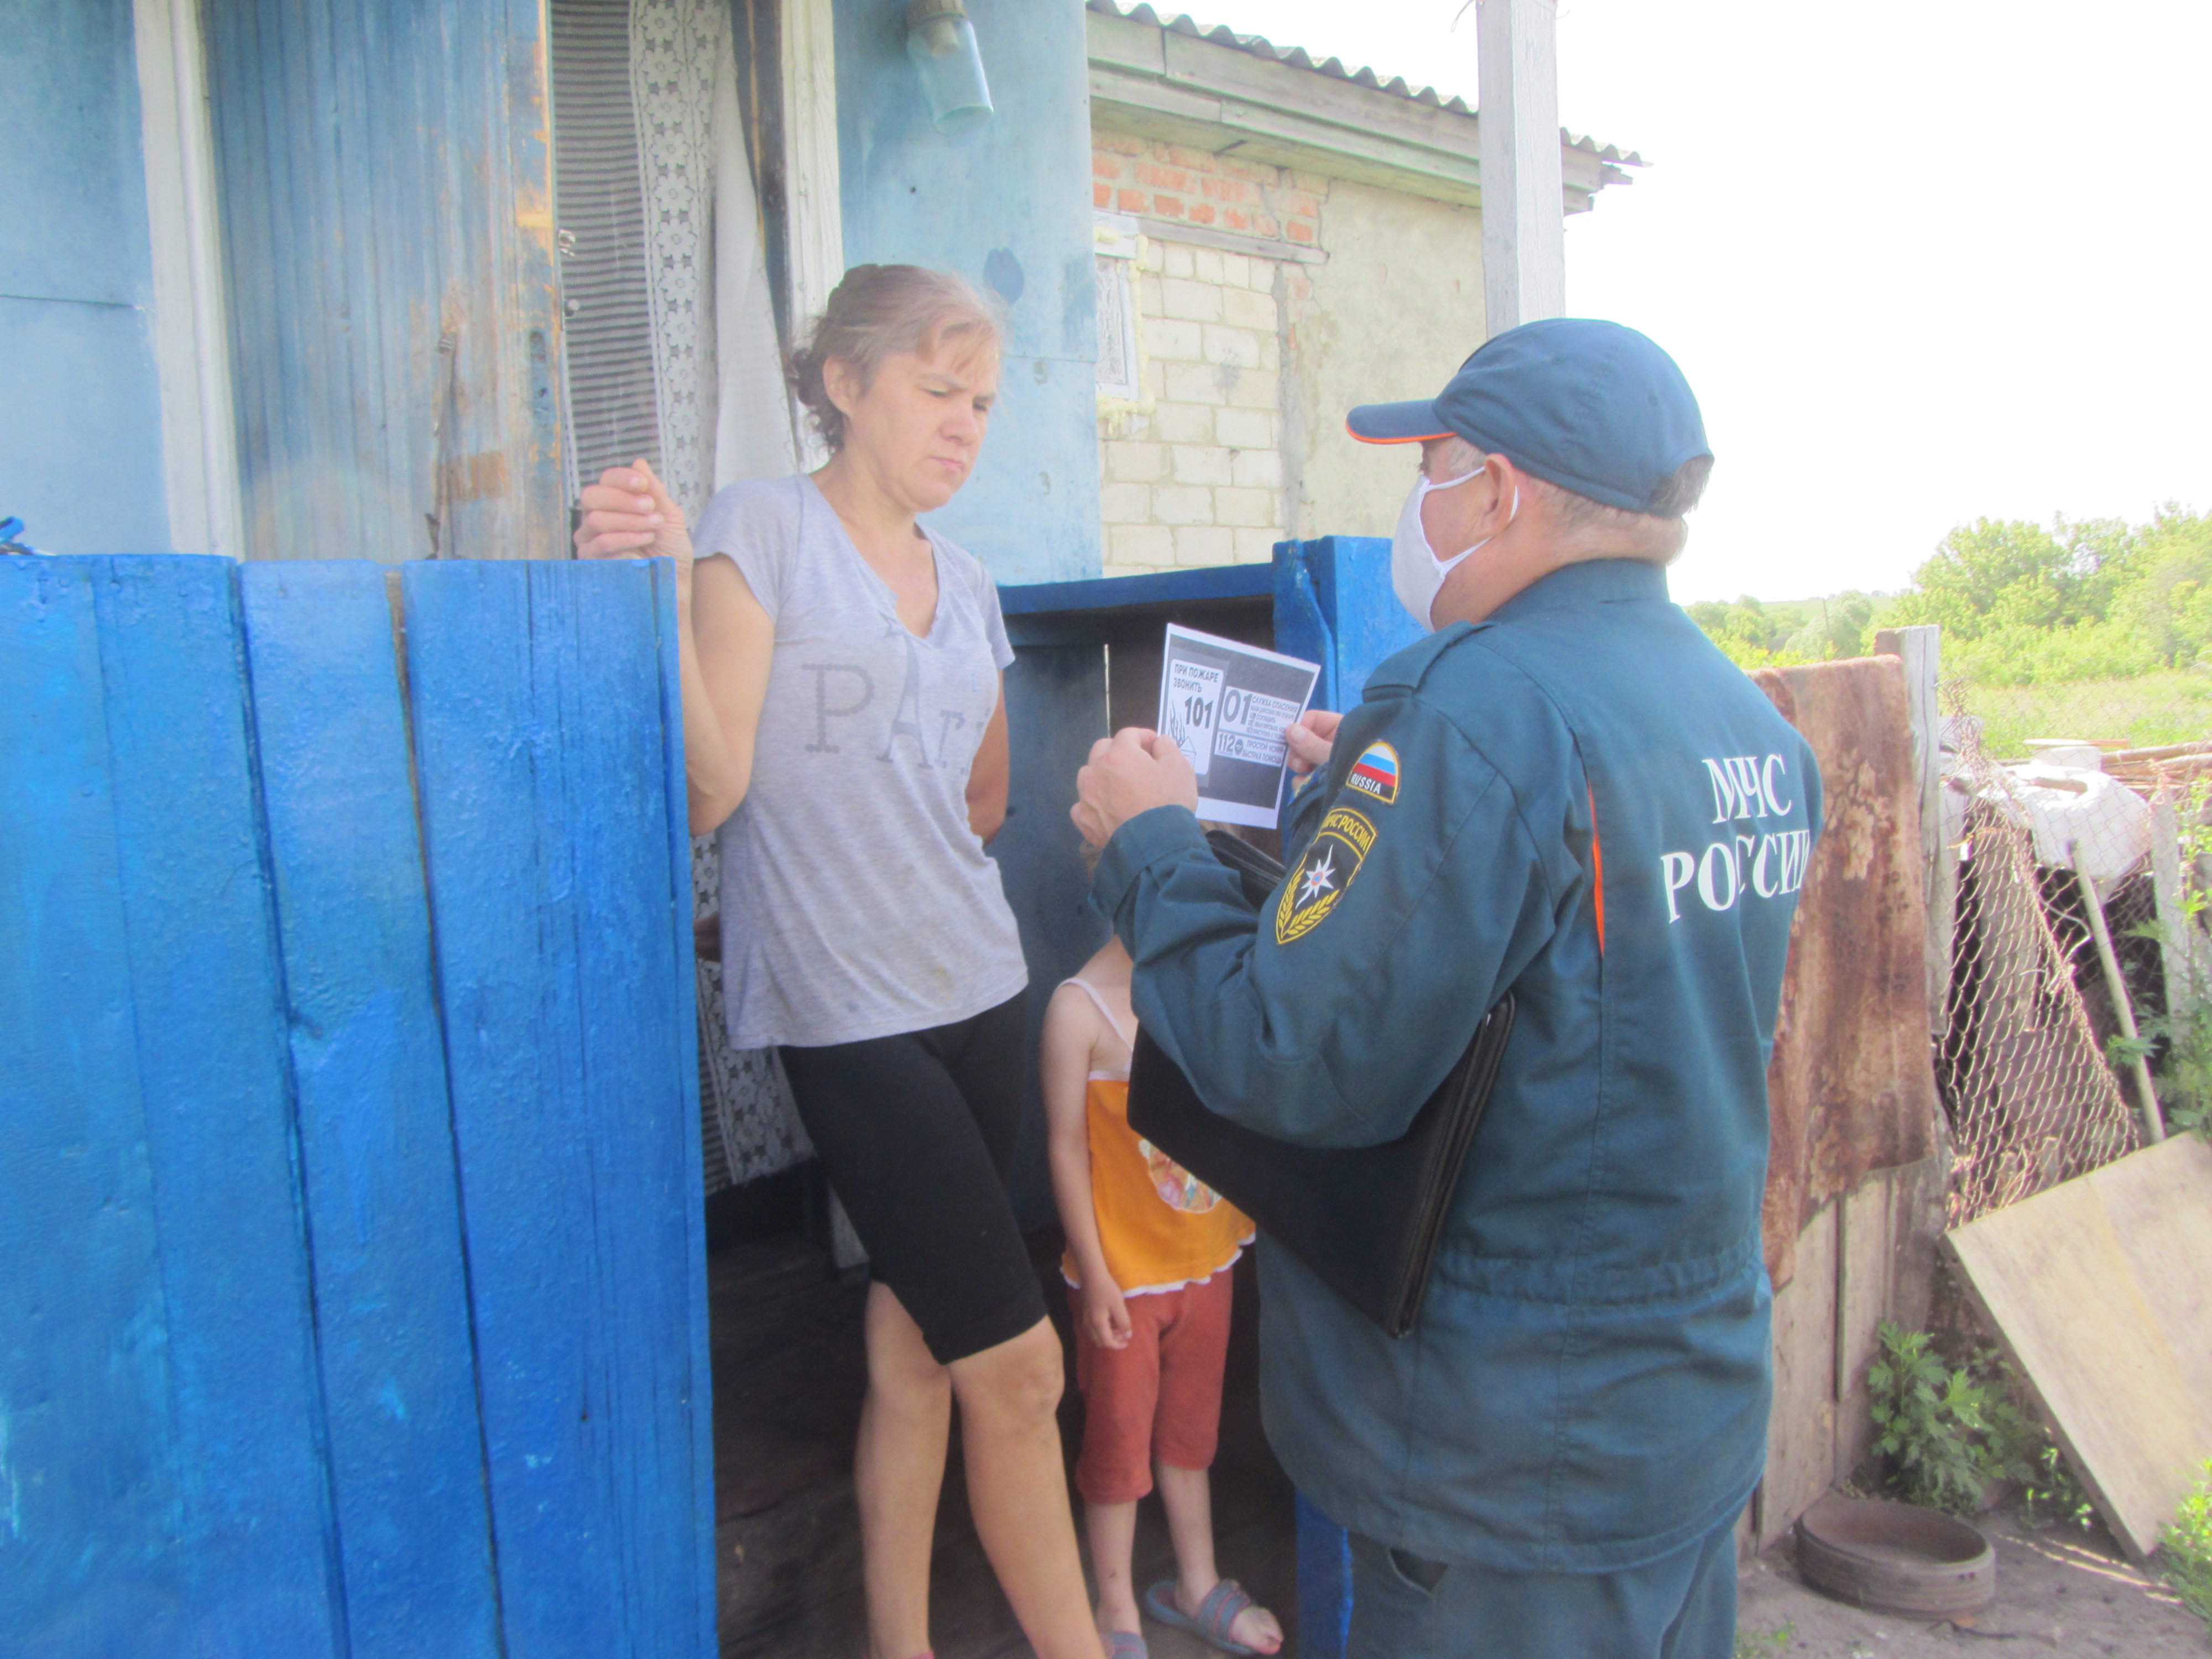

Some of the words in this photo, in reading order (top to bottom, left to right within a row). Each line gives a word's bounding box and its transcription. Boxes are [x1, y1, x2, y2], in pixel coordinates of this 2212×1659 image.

[1175, 664, 1188, 674] ПРИ
[1188, 666, 1219, 683] ПОЖАРЕ
[1173, 677, 1202, 693] ЗВОНИТЬ
[1185, 695, 1214, 729] 101
[1223, 689, 1253, 725] 01
[1252, 696, 1272, 707] СЛУЖБА
[1219, 733, 1235, 752] 112
[1350, 774, 1381, 795] RUSSIA
[1702, 754, 1791, 824] МЧС
[1337, 815, 1370, 852] РОССИИ
